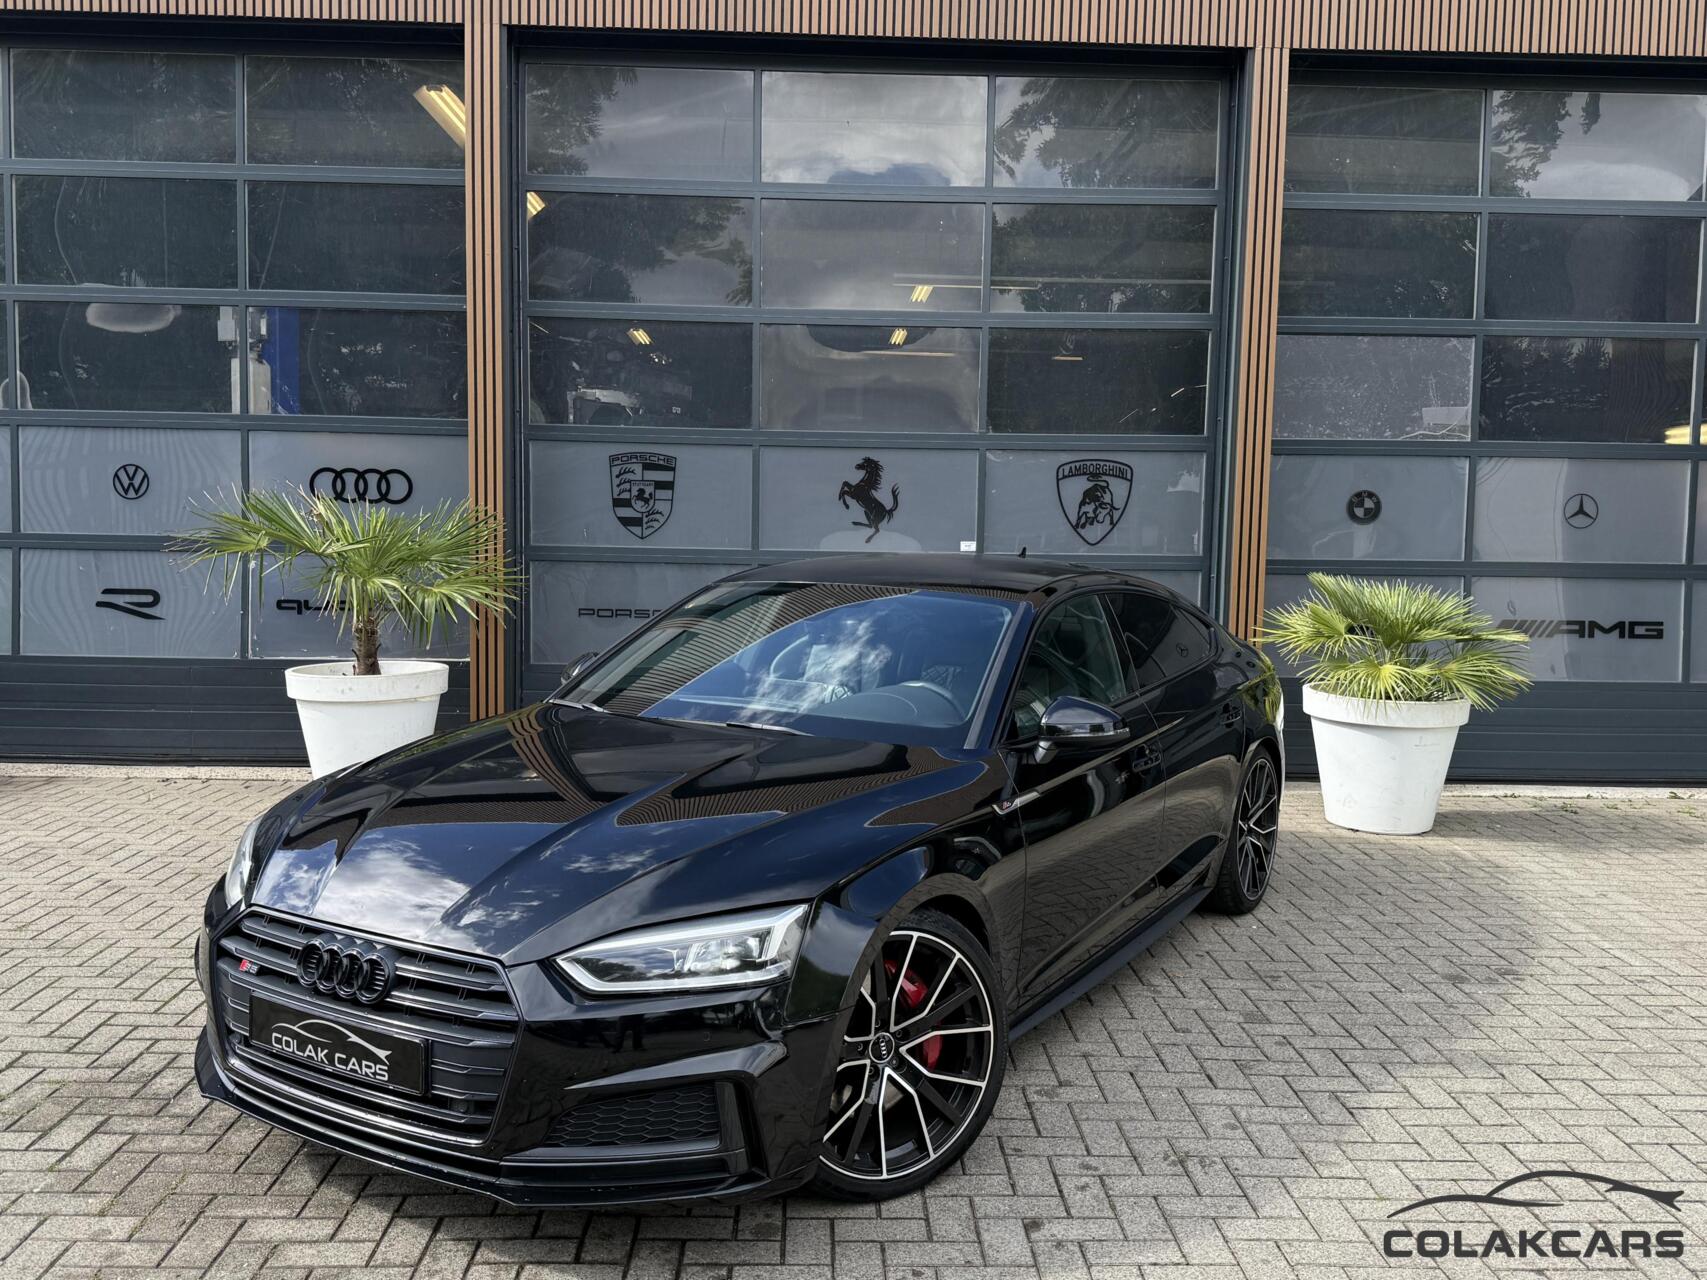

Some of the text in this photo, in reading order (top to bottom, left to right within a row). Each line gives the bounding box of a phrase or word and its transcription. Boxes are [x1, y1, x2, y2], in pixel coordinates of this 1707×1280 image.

[611, 454, 674, 466] PORSCHE
[1062, 463, 1128, 479] LAMBORGHINI
[271, 1032, 389, 1081] COLAK CARS
